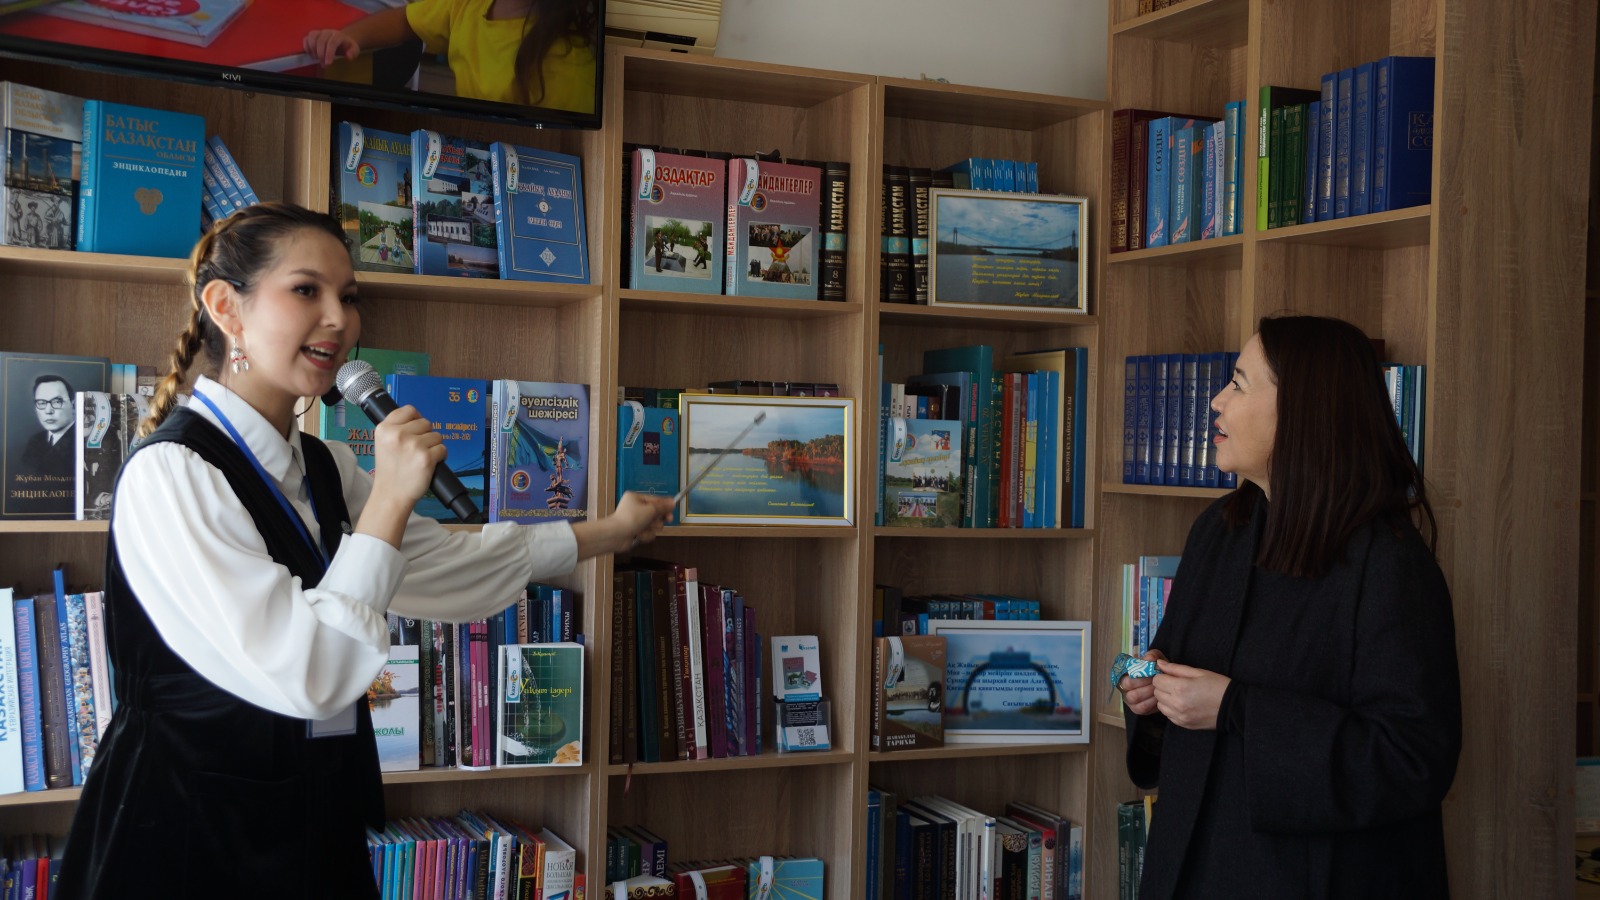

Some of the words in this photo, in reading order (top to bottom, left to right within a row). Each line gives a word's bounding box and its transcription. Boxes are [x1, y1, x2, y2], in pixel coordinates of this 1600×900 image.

[221, 72, 242, 82] KIVI
[105, 113, 159, 132] БАТЫС
[105, 130, 197, 154] ҚАЗАҚСТАН
[1155, 128, 1164, 172] СӨЗДІК
[156, 150, 196, 163] ОБЛЫСЫ
[112, 161, 188, 178] ЭНЦИКЛОПЕДИЯ
[655, 165, 716, 188] ОЗДАҚТАР
[757, 171, 814, 195] АЙДАНГЕРЛЕР
[831, 180, 845, 232] ҚАЗАҚСТАН
[892, 185, 907, 235] ҚАЗАҚСТАН
[832, 270, 839, 279] 8
[896, 273, 902, 282] 9
[518, 395, 579, 409] әуелсіздік
[528, 408, 579, 421] шежіресі
[16, 606, 32, 669] КОНСТИТУЦИЯСЫ
[60, 621, 68, 644] ATLAS
[62, 645, 72, 687] GEOGRAPHY
[64, 687, 76, 733] KAZAKHSTAN
[696, 673, 705, 727] ҚАЗАҚСТАН
[886, 738, 916, 747] ТАРИХЫ
[547, 862, 573, 872] НОВАЯ
[1031, 854, 1040, 894] ТАРИХЫ
